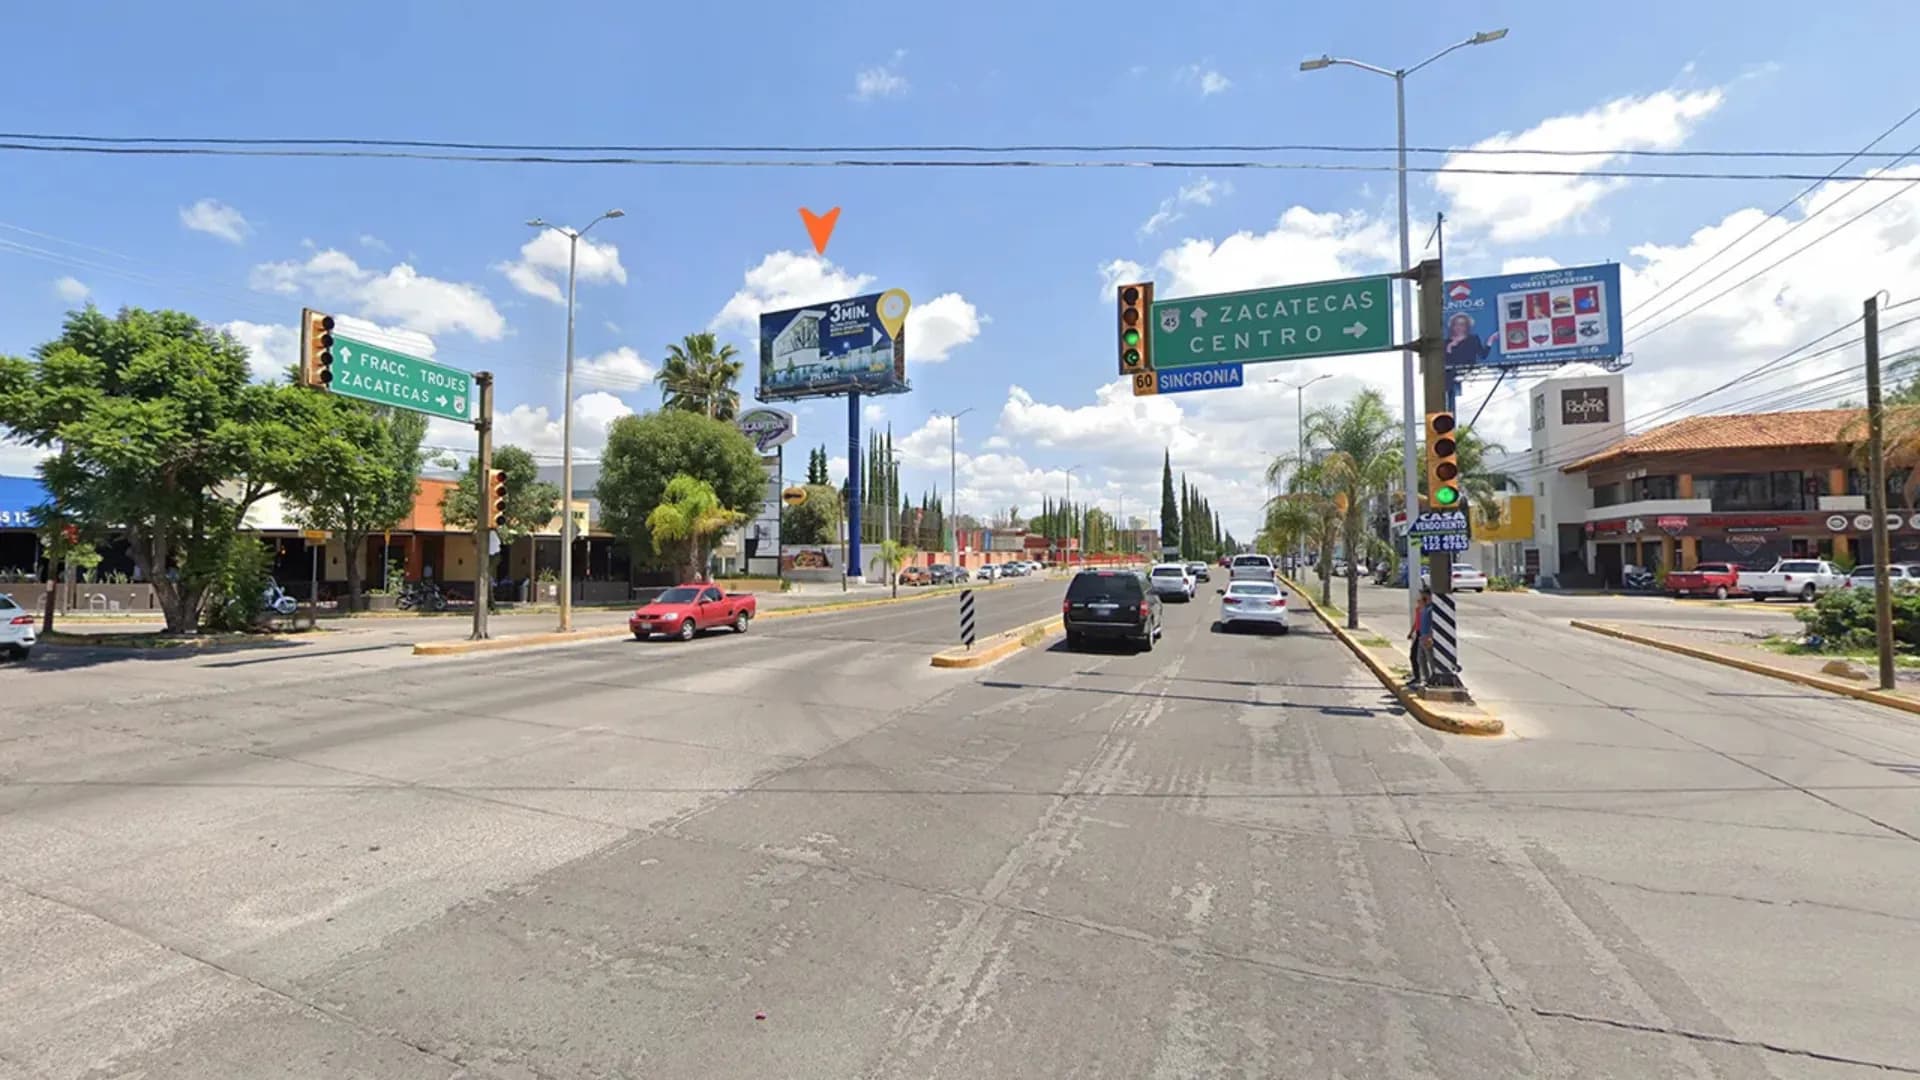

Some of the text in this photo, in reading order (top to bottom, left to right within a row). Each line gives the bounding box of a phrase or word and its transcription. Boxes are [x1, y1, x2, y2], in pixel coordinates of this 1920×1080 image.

[830, 303, 870, 322] 3 MIN.
[1219, 290, 1375, 324] ZACATECAS
[1163, 317, 1177, 328] 45
[1190, 325, 1322, 353] CENTRO
[360, 353, 466, 393] FRACC. TROJES
[1136, 373, 1153, 389] 60
[1160, 367, 1240, 390] SINCRONIA
[341, 370, 430, 404] ZACATECAS
[1416, 519, 1467, 531] VENDO RENTO
[1420, 512, 1465, 521] CASA
